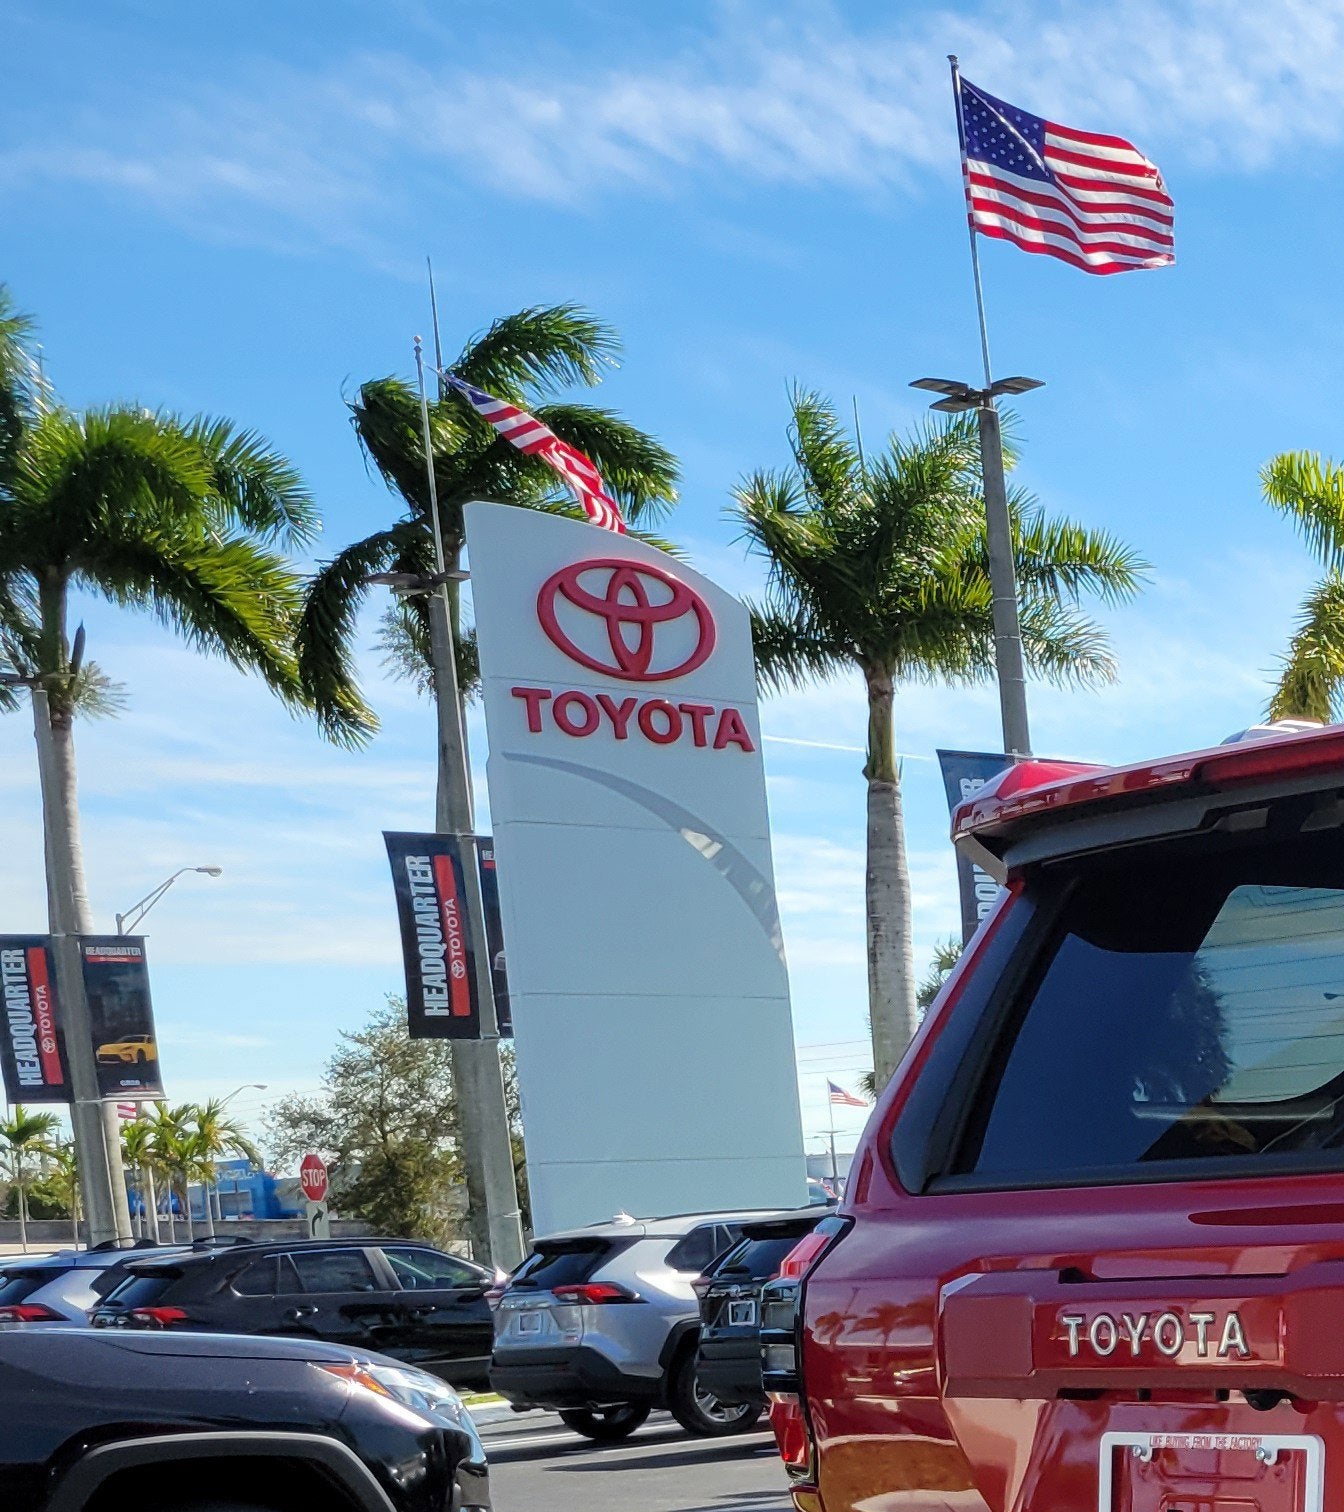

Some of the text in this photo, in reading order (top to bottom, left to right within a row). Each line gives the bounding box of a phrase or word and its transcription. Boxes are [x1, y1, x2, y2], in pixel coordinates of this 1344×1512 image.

[511, 686, 756, 753] TOYOTA
[405, 855, 449, 1017] HEADQUARTER
[444, 898, 463, 956] TOYOTA
[0, 949, 45, 1086] HEADQUARTER
[36, 985, 51, 1036] TOYOTA
[302, 1169, 325, 1187] STOP
[1062, 1312, 1250, 1357] TOYOTA
